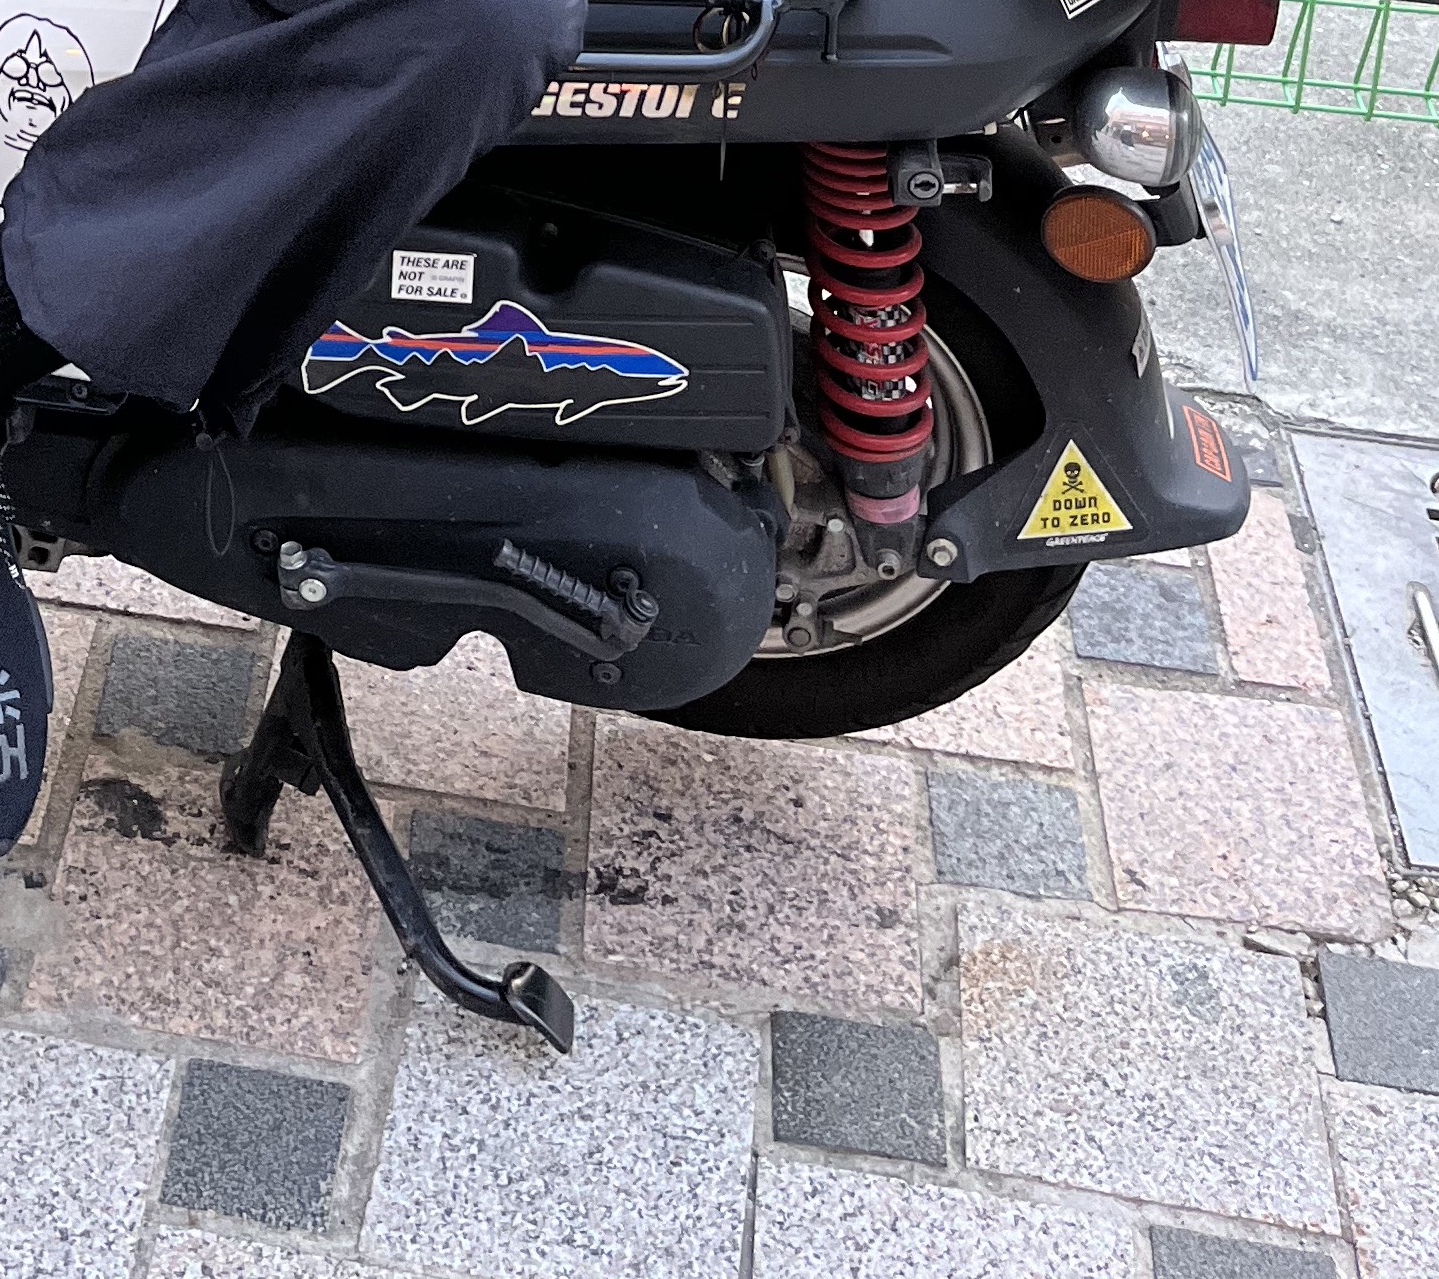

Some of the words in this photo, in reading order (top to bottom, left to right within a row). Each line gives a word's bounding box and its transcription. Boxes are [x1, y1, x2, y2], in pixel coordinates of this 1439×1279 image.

[399, 256, 441, 269] THESE
[442, 259, 469, 271] ARE
[398, 270, 425, 282] NOT
[397, 284, 423, 296] FOR
[426, 286, 459, 298] SALE
[1053, 496, 1098, 511] DOWN
[1040, 516, 1060, 529] TO
[1069, 511, 1111, 527] ZERO
